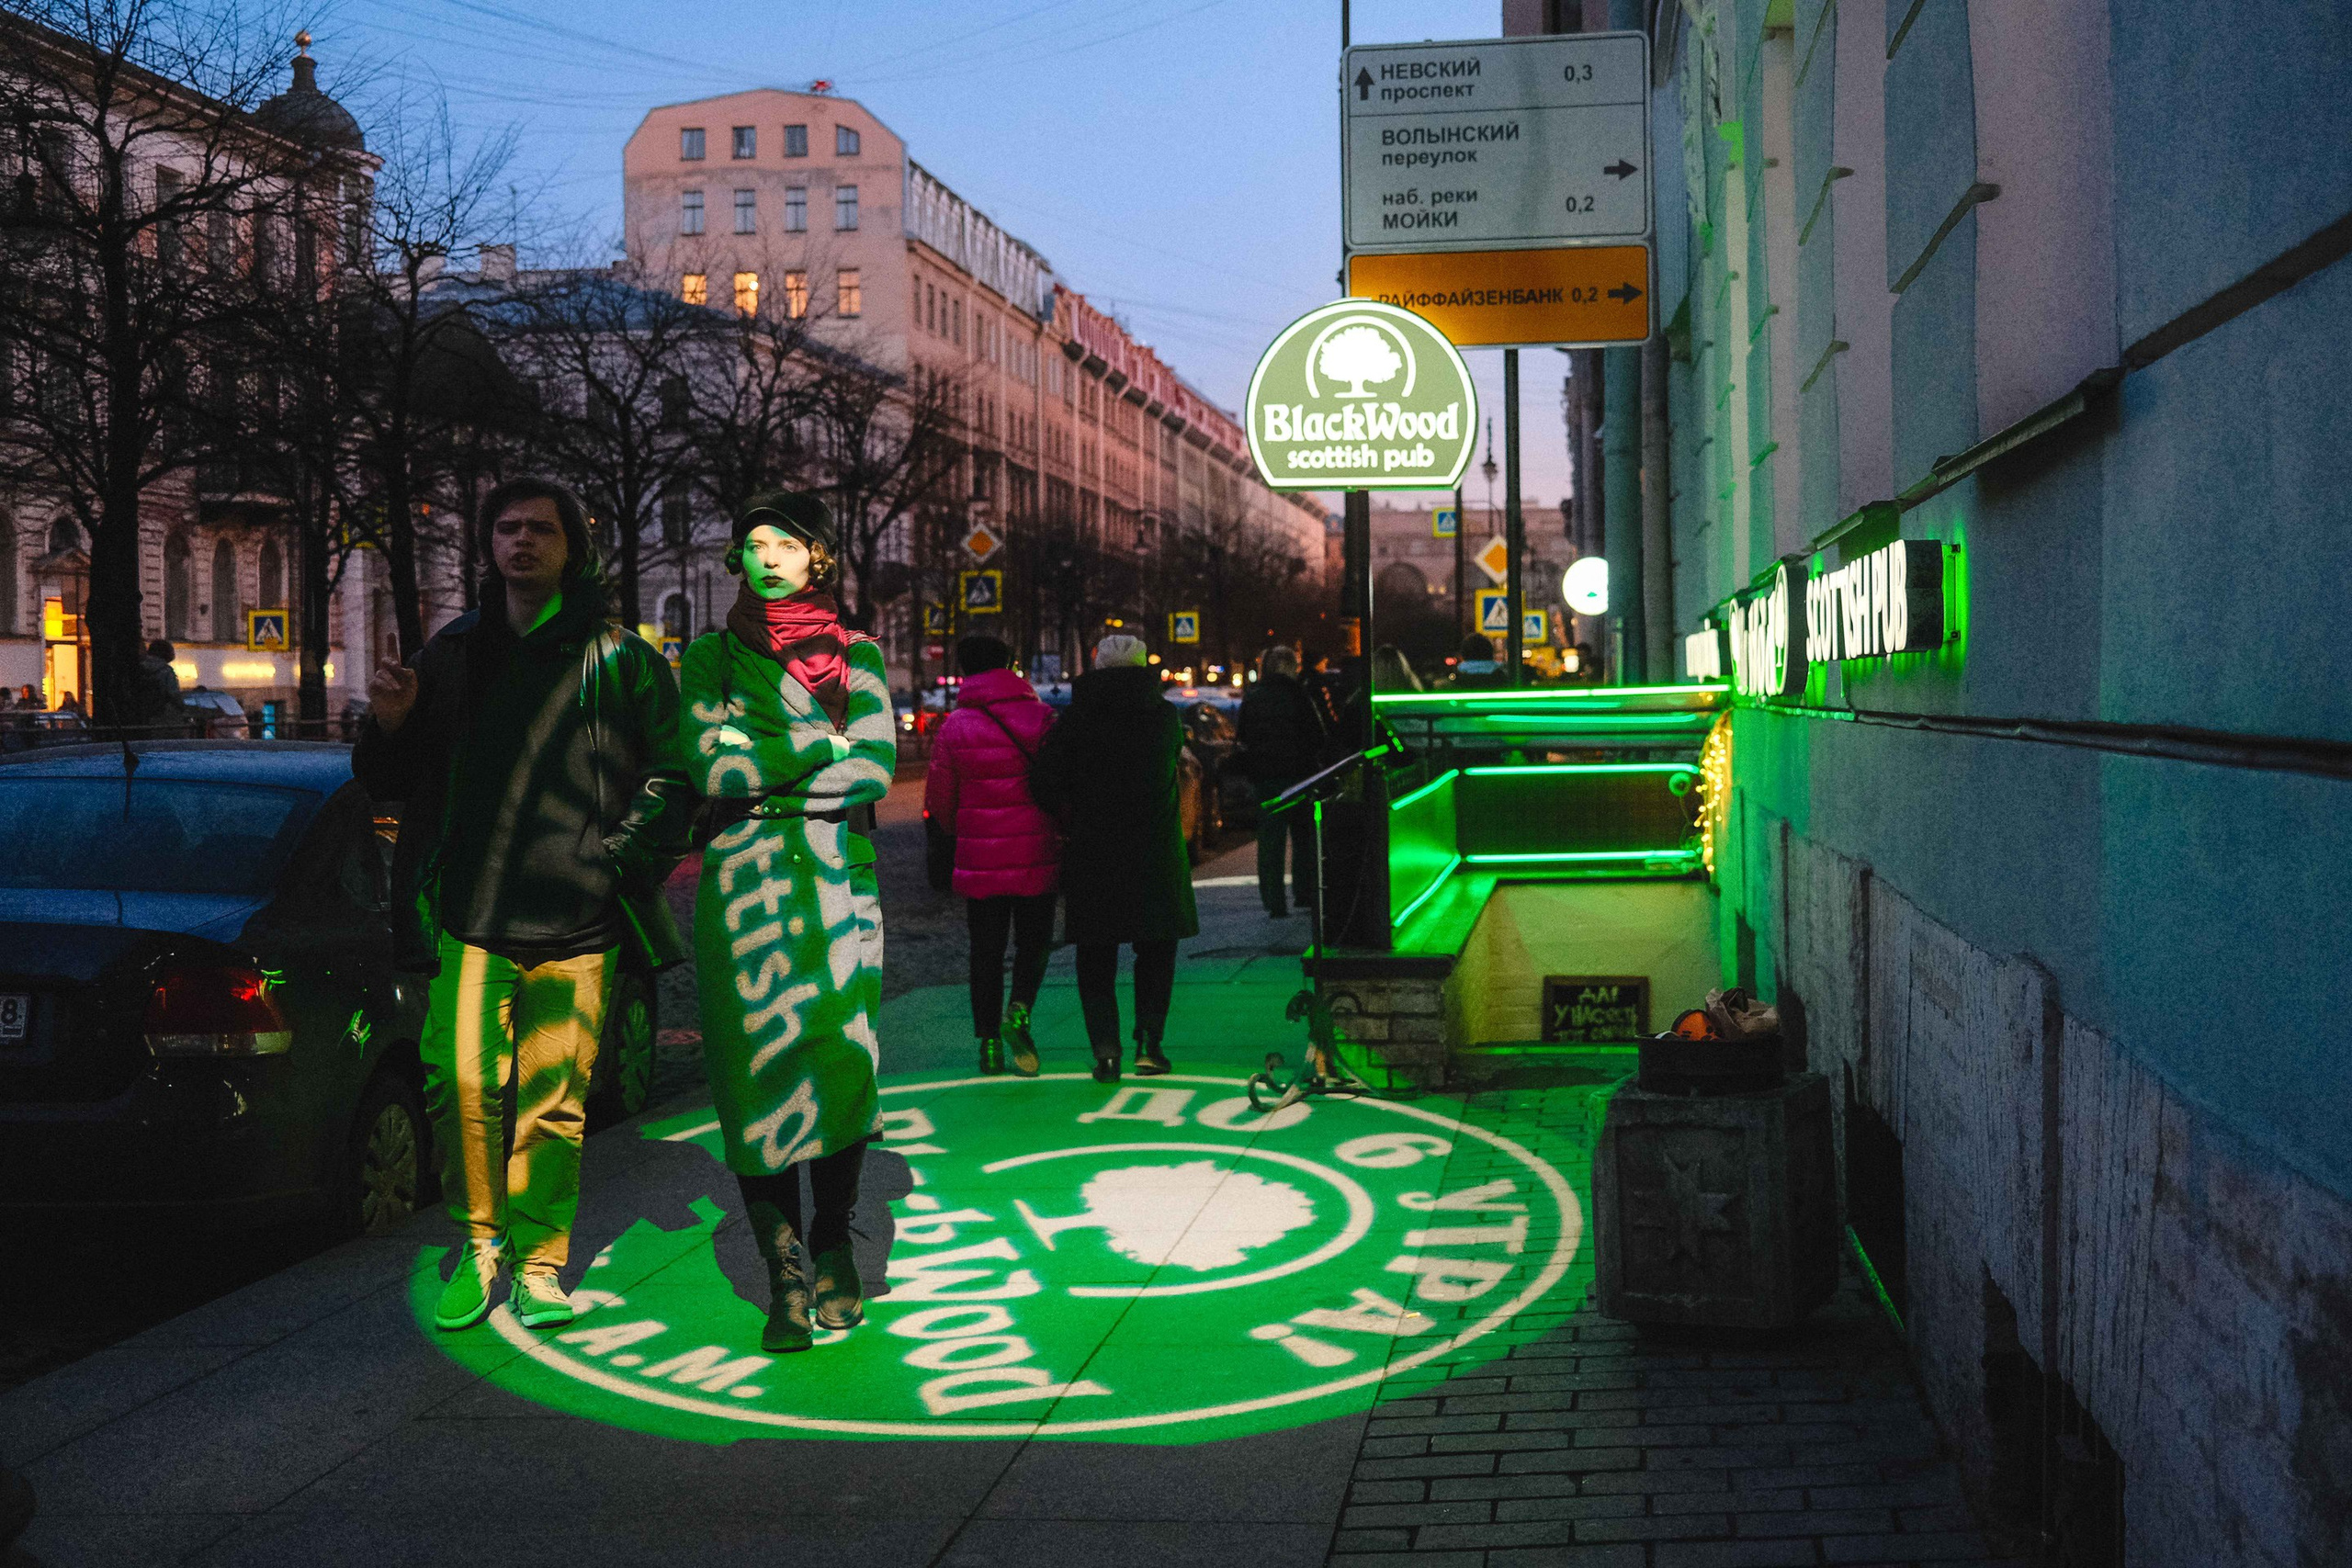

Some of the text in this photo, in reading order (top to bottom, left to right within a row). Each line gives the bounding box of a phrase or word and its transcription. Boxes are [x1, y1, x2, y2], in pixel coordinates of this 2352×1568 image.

[1381, 57, 1481, 80] НЕВСКИЙ
[1565, 65, 1593, 85] 0,3
[1382, 85, 1475, 103] проспект
[1382, 121, 1520, 147] ВОЛЫНСКИЙ
[1382, 150, 1477, 168] переулок
[1383, 189, 1477, 208] наб. реки
[1566, 196, 1595, 214] 0,2
[1383, 209, 1458, 229] МОЙКИ
[1378, 285, 1599, 309] РАЙФФАЙЗЕНБАНК 0,2
[1263, 401, 1459, 442] BlackWood
[1287, 443, 1435, 471] scottish pub
[1806, 555, 1870, 662] SCOTTISH
[1871, 539, 1907, 654] PUB
[1077, 1087, 1312, 1133] ДО
[1334, 1133, 1453, 1168] 6
